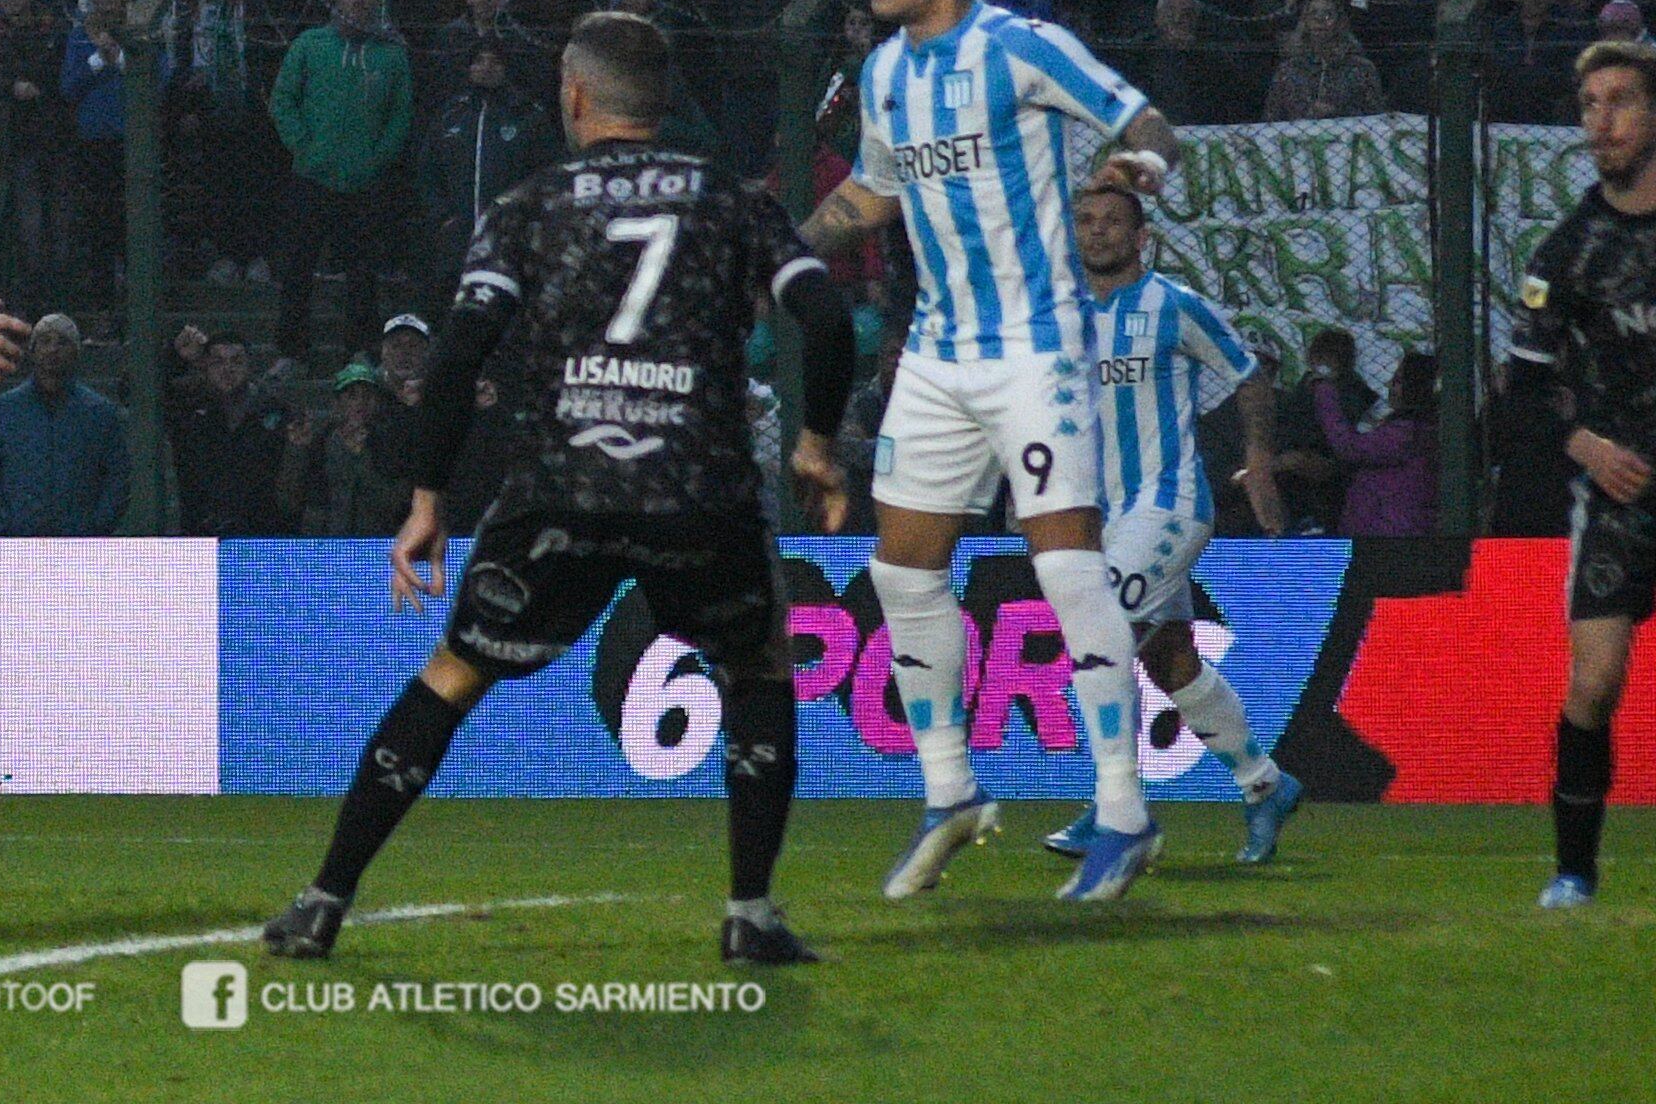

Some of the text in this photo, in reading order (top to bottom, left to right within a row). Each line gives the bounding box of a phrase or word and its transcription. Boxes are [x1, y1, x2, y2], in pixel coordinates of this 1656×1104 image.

[605, 214, 680, 345] 7
[563, 354, 694, 394] LISANDRO
[1022, 442, 1054, 496] 9
